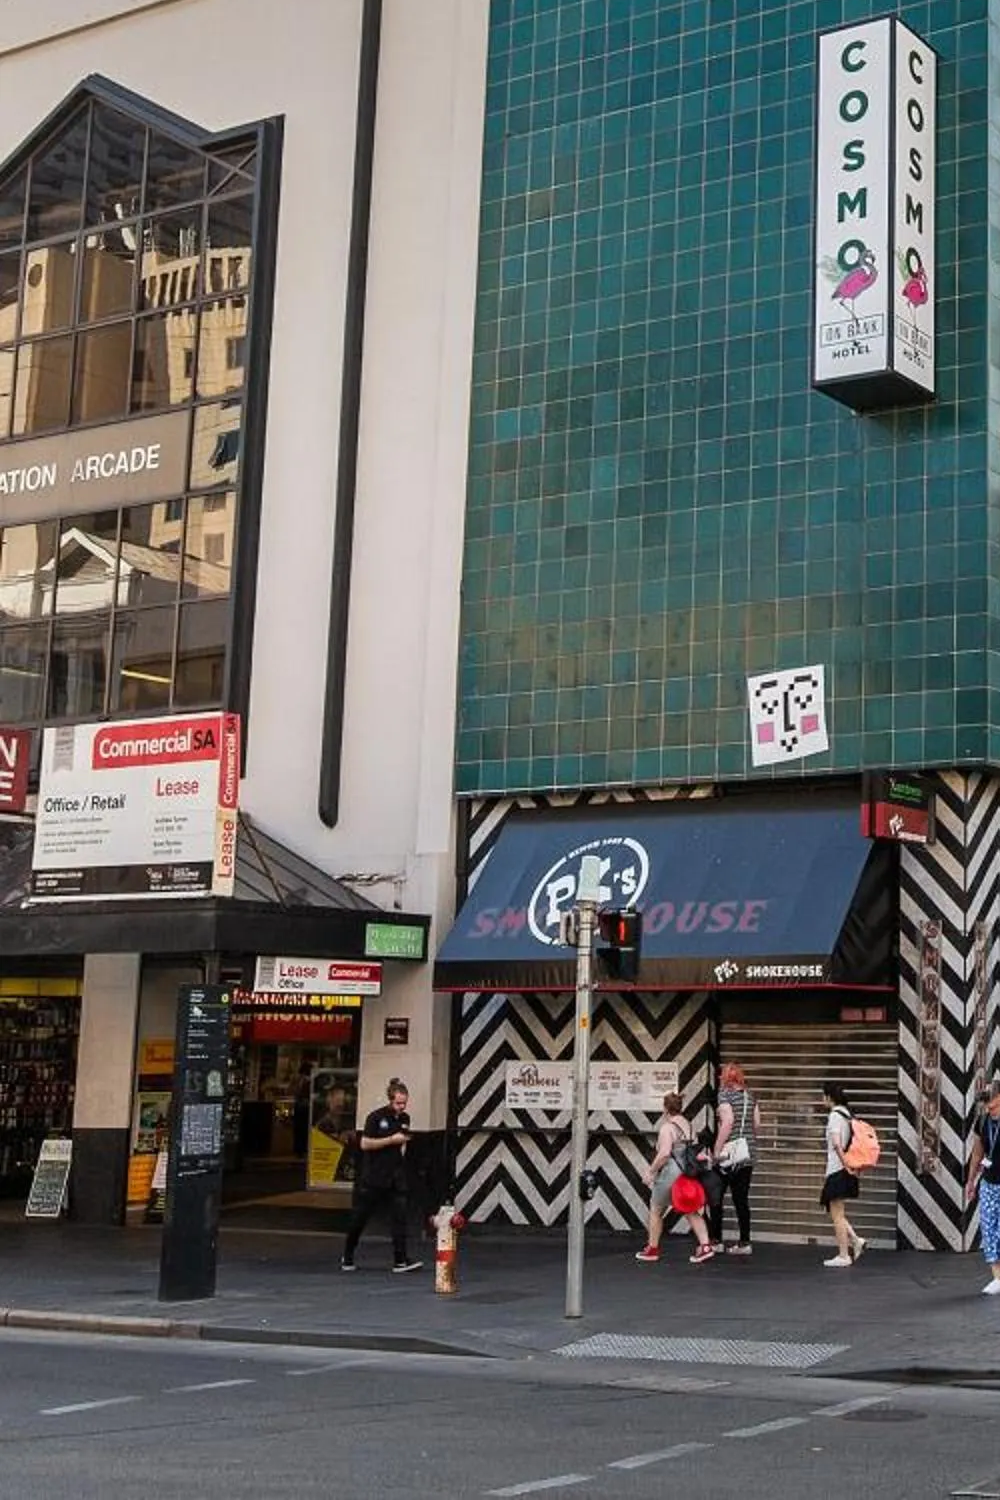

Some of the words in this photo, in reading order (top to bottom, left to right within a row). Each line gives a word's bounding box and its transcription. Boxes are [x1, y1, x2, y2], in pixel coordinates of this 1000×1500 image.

[837, 40, 869, 273] COSMO
[905, 50, 924, 279] COSMO
[832, 345, 870, 359] HOTEL
[71, 443, 161, 482] ARCADE
[156, 777, 199, 797] Lease
[44, 797, 80, 813] Office
[91, 794, 126, 811] Retail
[217, 819, 235, 879] Lease
[279, 964, 319, 978] Lease
[745, 964, 823, 978] SMOKEHOUSE
